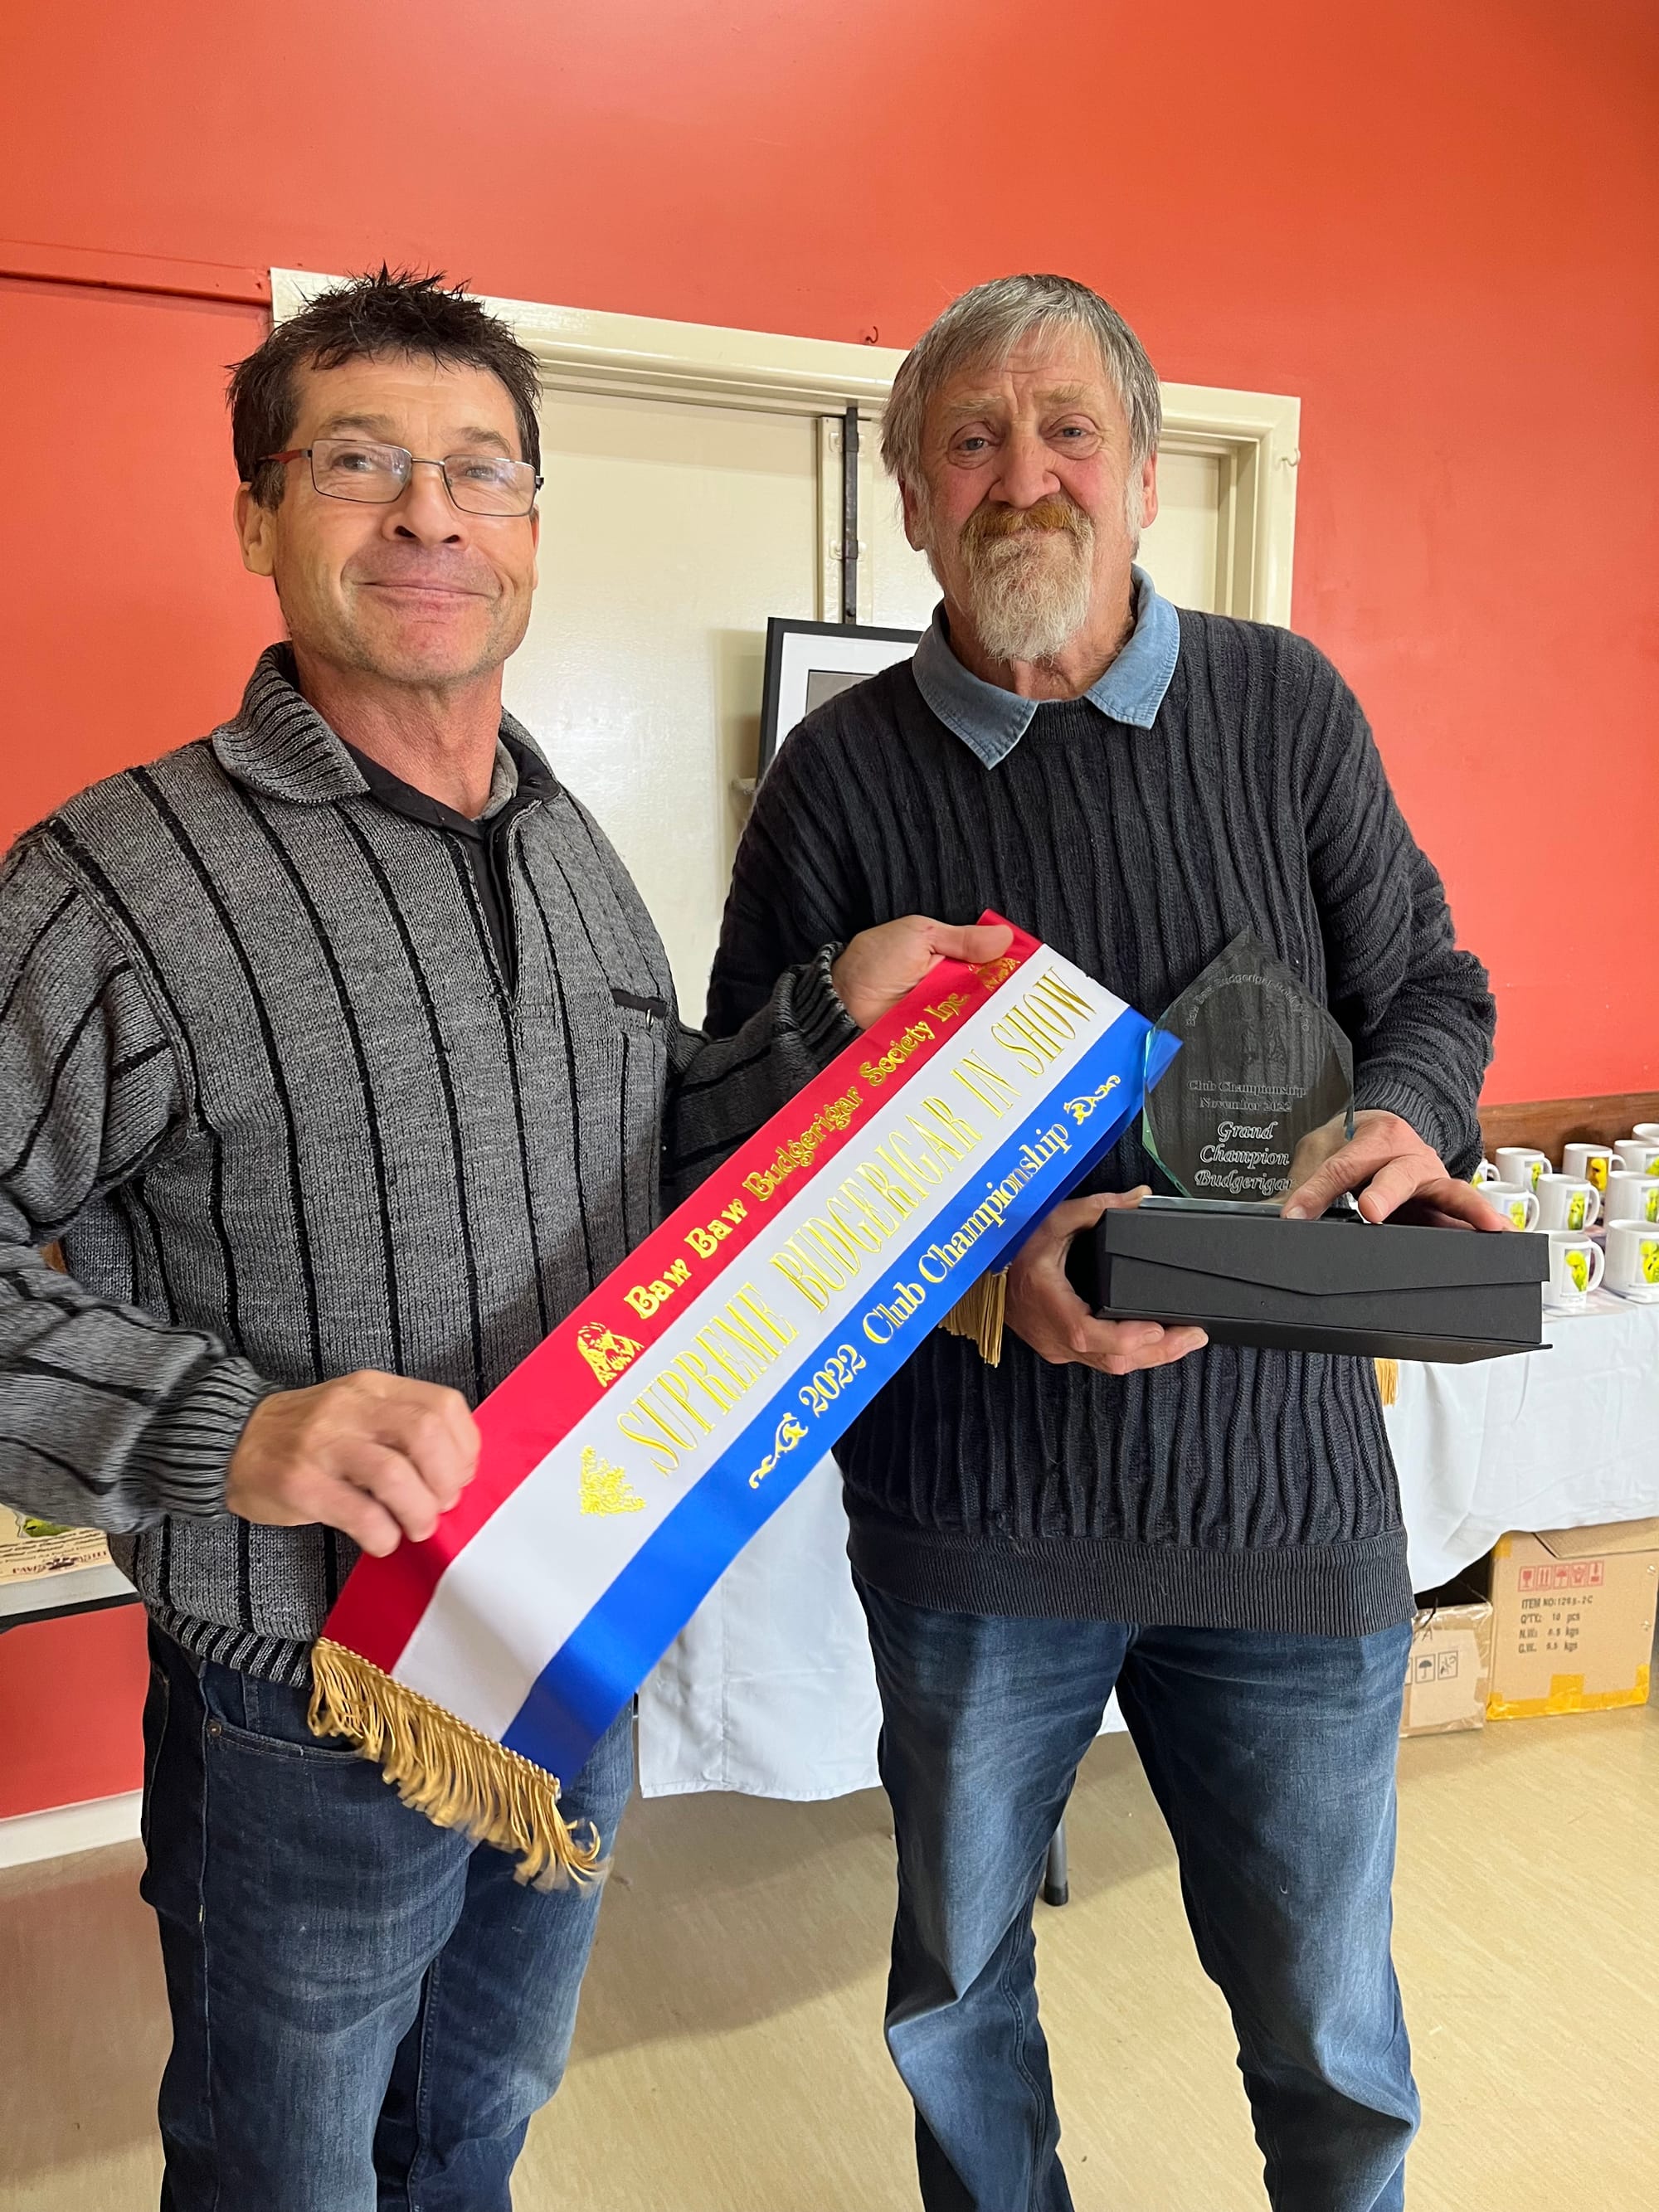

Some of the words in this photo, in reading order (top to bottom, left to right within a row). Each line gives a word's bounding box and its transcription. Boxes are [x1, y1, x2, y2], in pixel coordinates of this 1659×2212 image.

[1187, 1081, 1216, 1091] Club
[1219, 1081, 1306, 1098] Championship
[1199, 1097, 1261, 1111] November
[1263, 1101, 1292, 1112] 2022
[1217, 1121, 1278, 1142] Grand
[1199, 1143, 1290, 1169] Champion
[624, 1258, 692, 1321] Baw
[684, 1199, 748, 1260] Baw
[742, 1085, 863, 1202] Budgerigar
[859, 1020, 937, 1087] Society
[616, 1282, 800, 1475] SUPREME
[769, 1096, 984, 1314] BUDGERIGAR
[951, 1048, 1022, 1119] IN
[990, 966, 1097, 1077] SHOW
[799, 1344, 868, 1418] 2022
[862, 1282, 927, 1345] Club
[918, 1122, 1072, 1286] Championship
[1521, 1597, 1541, 1609] ITEM
